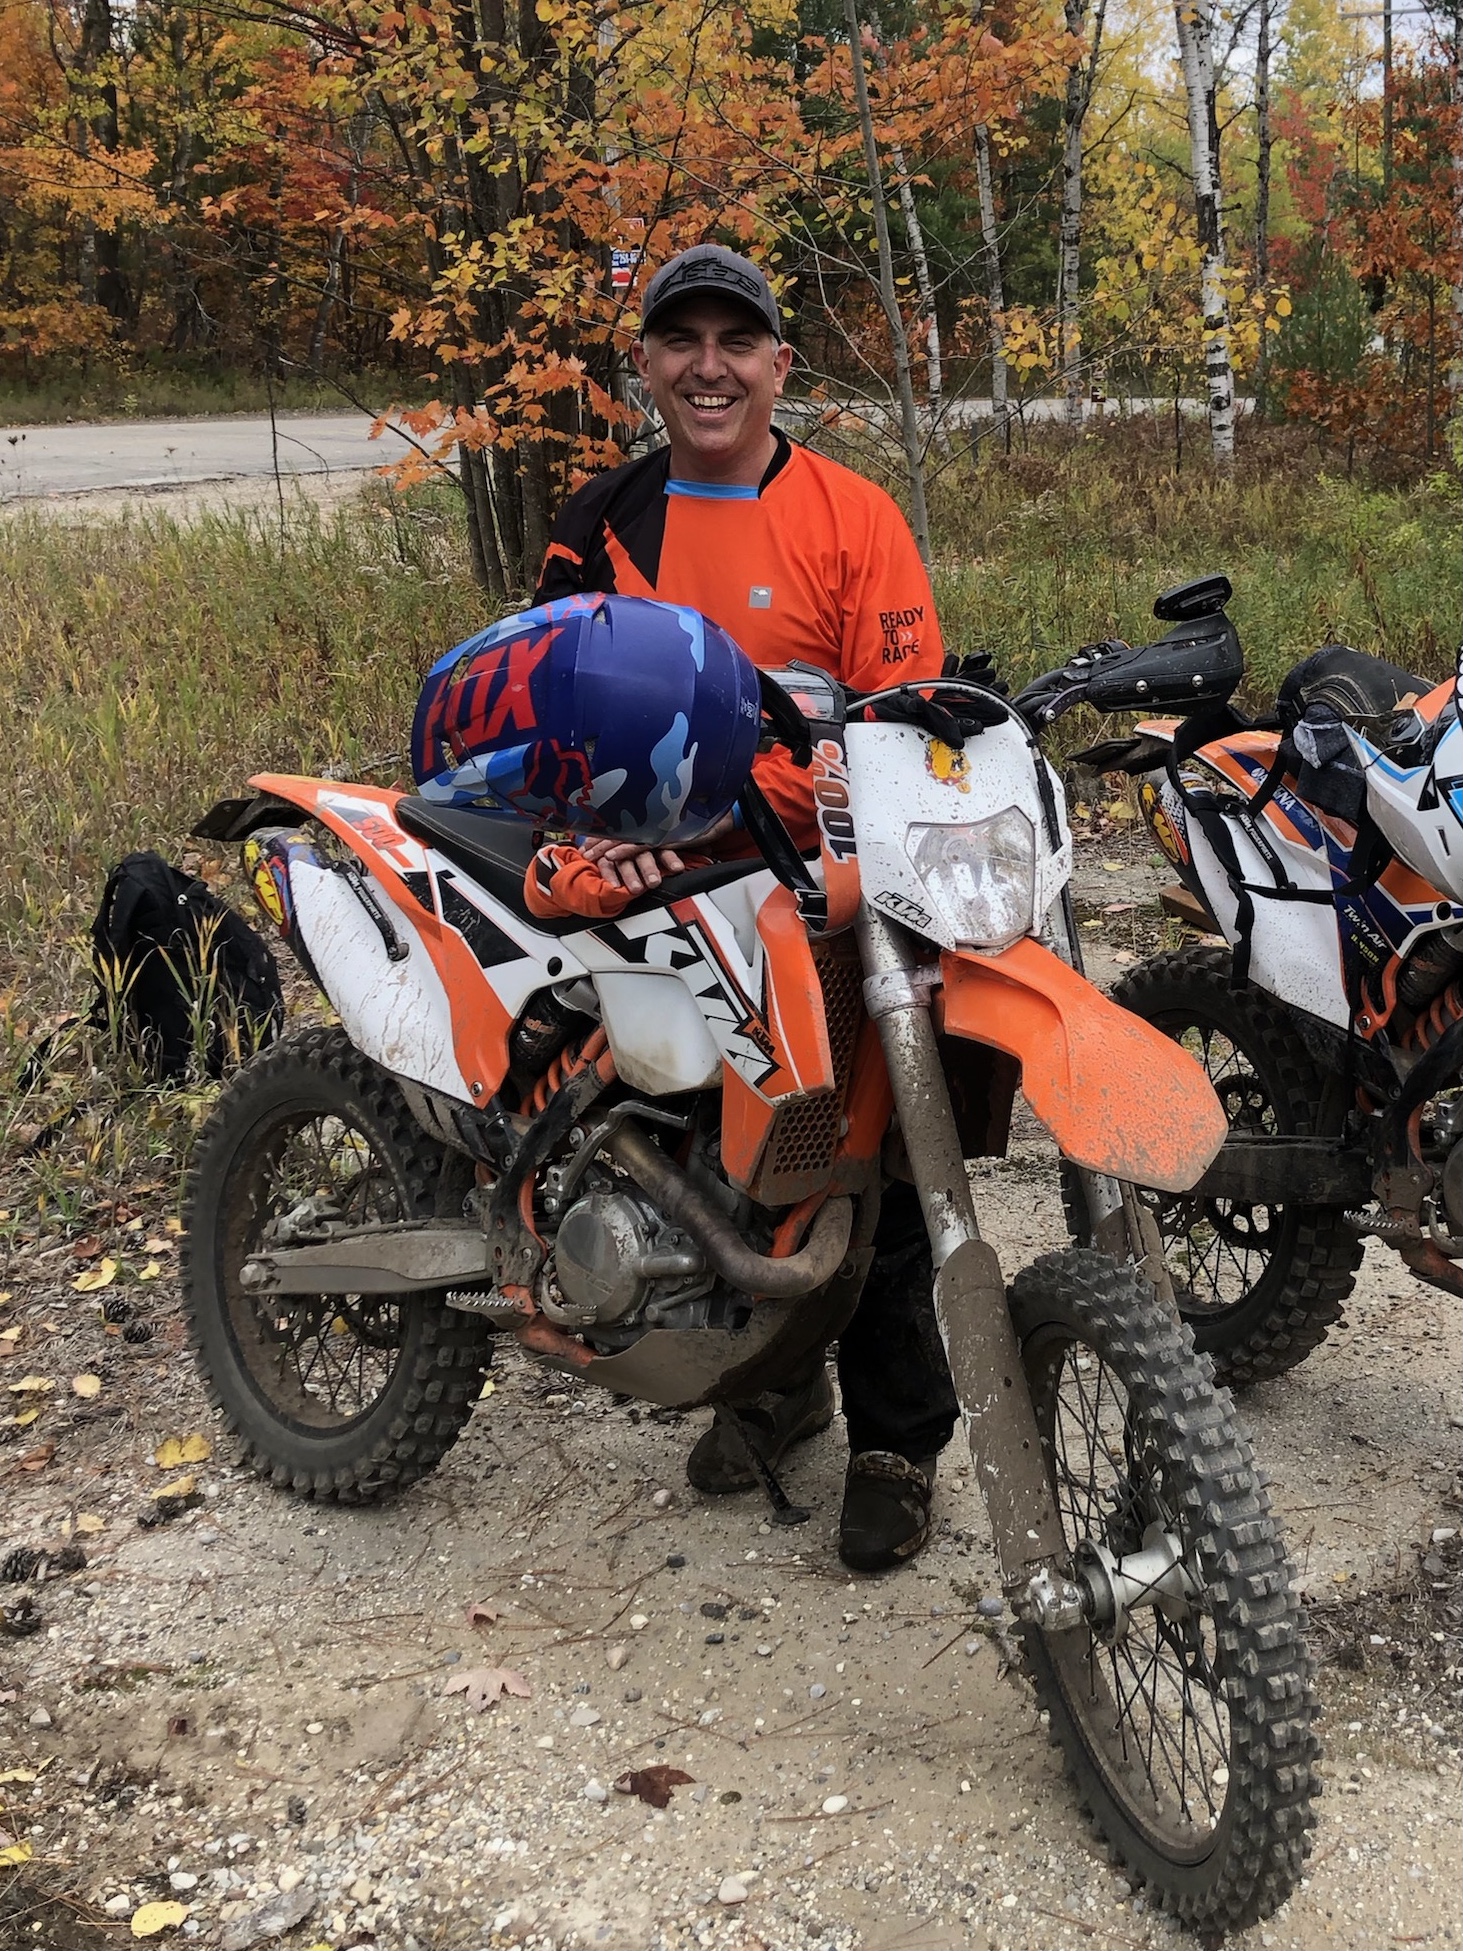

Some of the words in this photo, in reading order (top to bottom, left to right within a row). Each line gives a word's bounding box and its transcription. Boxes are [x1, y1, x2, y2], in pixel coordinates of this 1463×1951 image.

[878, 606, 925, 630] READY
[883, 629, 900, 647] TO
[422, 627, 565, 772] FOX
[811, 738, 859, 864] 100%
[874, 890, 932, 928] KTM
[1367, 931, 1388, 949] Air
[615, 906, 773, 1085] KTM
